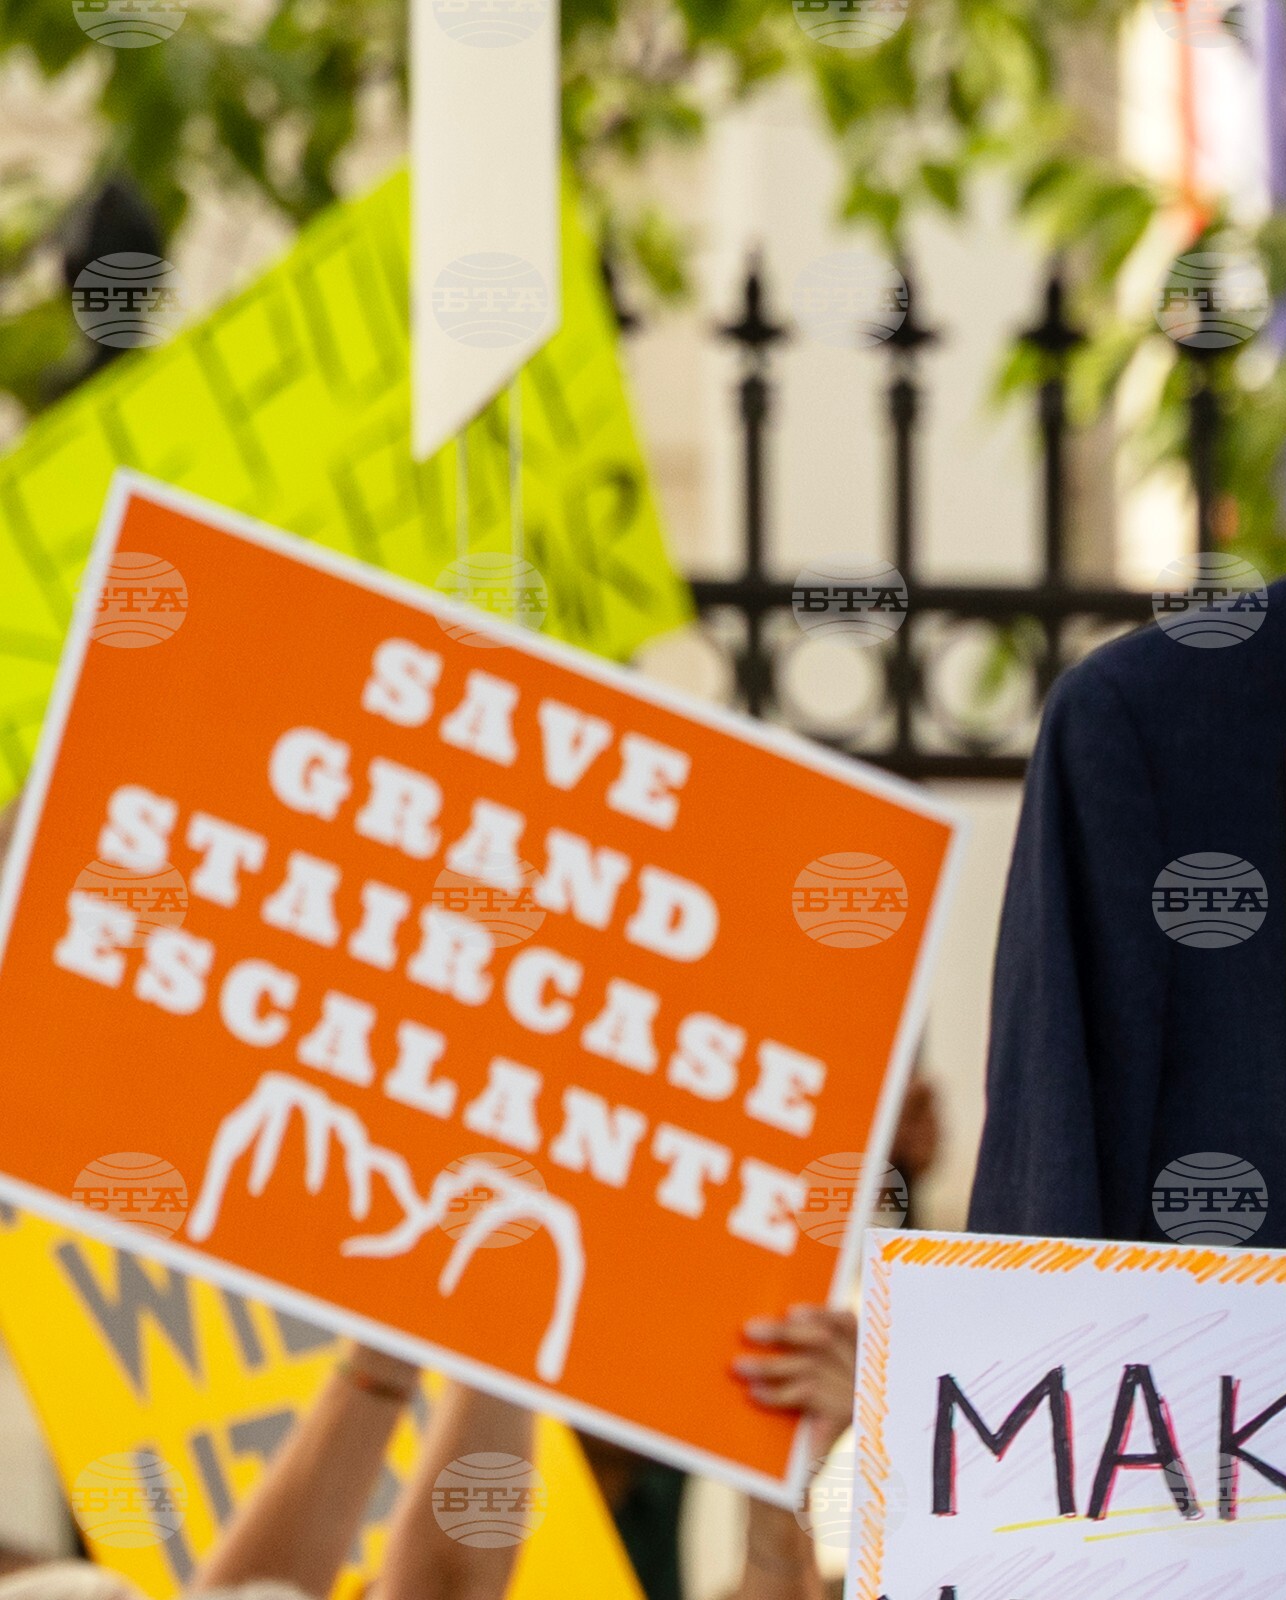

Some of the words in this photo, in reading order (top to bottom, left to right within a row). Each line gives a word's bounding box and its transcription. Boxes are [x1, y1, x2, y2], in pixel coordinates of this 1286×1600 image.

[269, 726, 718, 963] GRAND
[362, 637, 691, 828] SAVE
[53, 889, 805, 1255] ESCALANTE
[97, 784, 828, 1138] STAIRCASE
